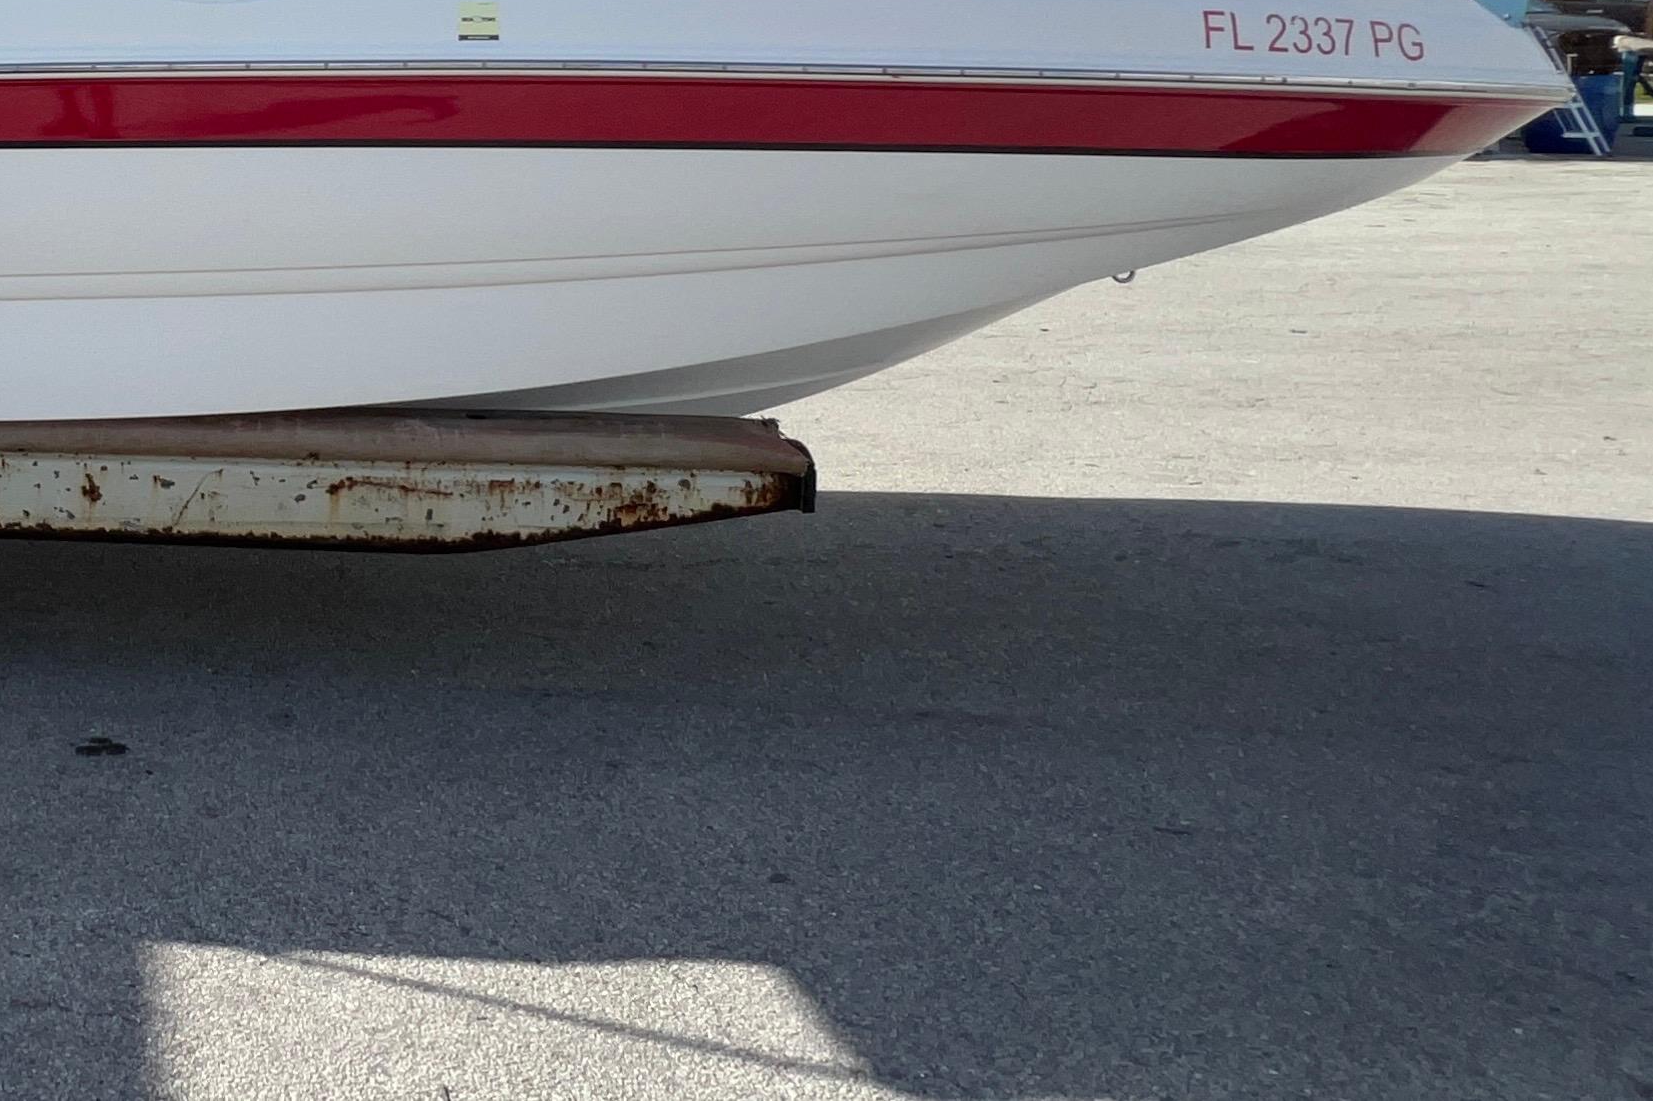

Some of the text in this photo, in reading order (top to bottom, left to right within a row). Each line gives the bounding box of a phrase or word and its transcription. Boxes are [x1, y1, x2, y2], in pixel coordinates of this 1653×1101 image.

[1202, 10, 1425, 62] FL 2337 PG
